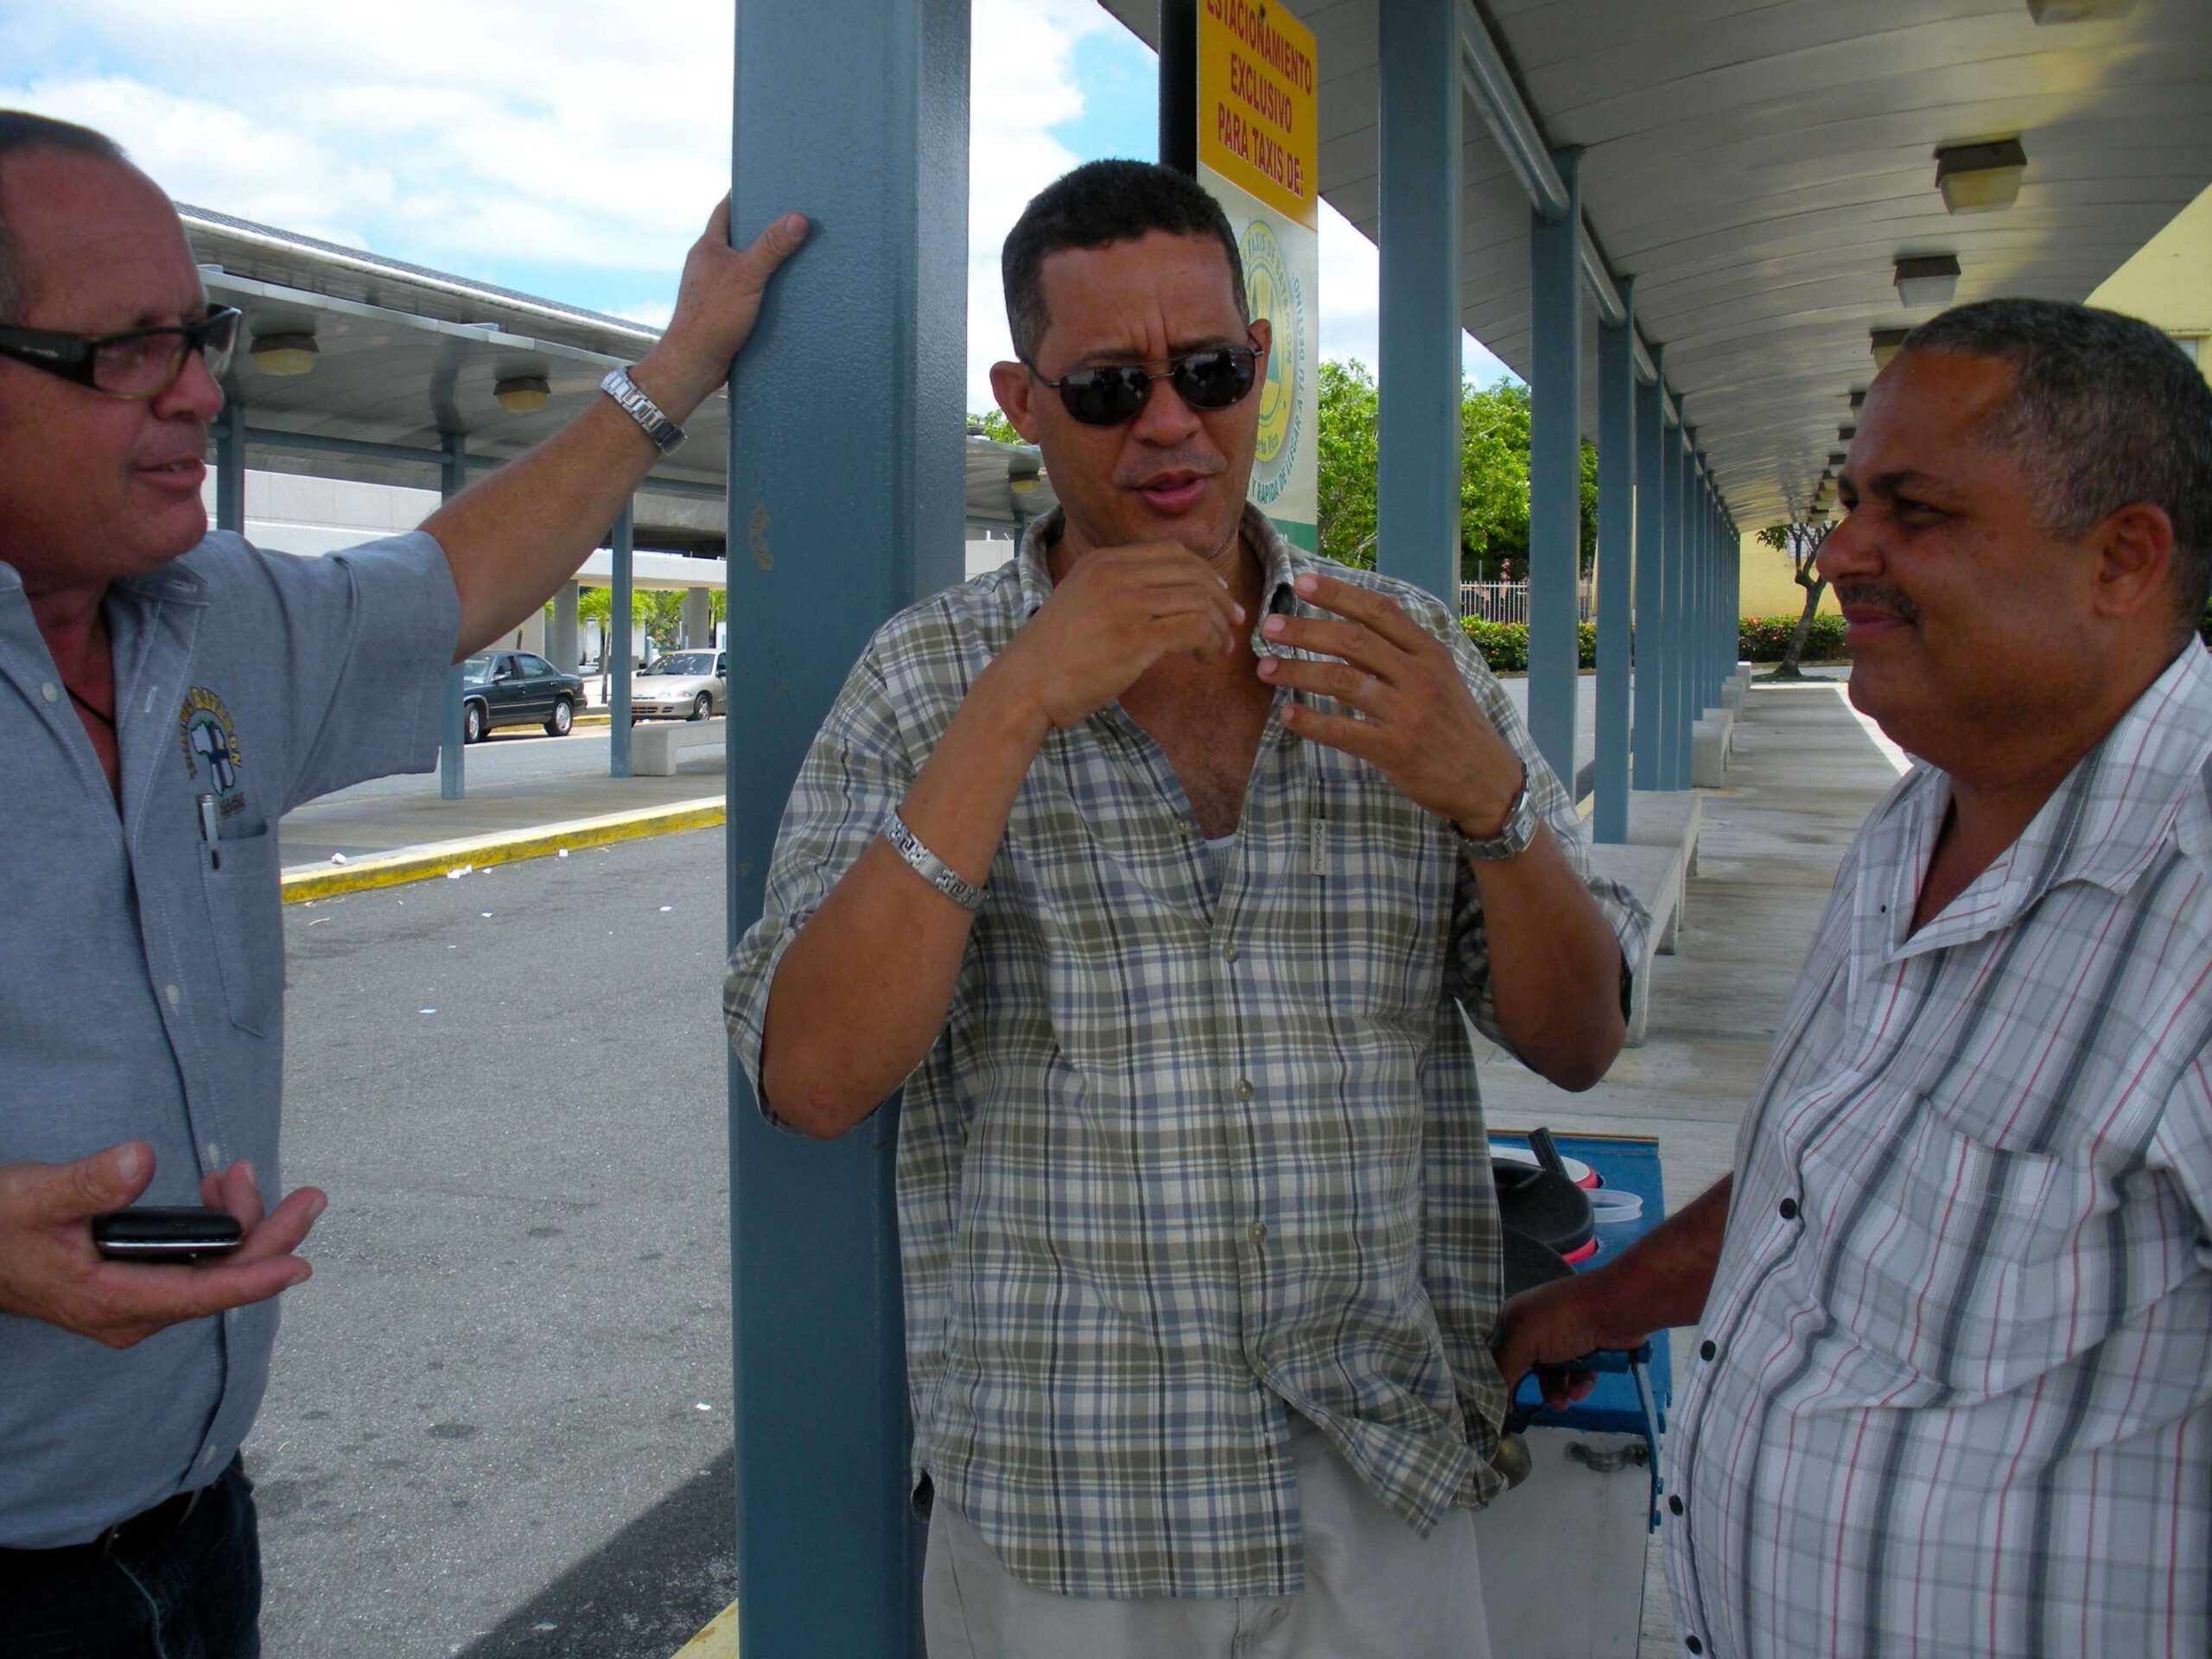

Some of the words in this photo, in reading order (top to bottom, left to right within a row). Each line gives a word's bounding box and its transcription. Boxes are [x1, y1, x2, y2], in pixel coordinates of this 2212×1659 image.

[1206, 0, 1312, 97] STACIONAMIENTO
[1230, 52, 1292, 135] EXCLUSIVO
[1217, 102, 1249, 162] PARA
[1251, 126, 1283, 185] TAXIS
[1257, 479, 1280, 505] RAPIDA
[1279, 467, 1287, 492] DE
